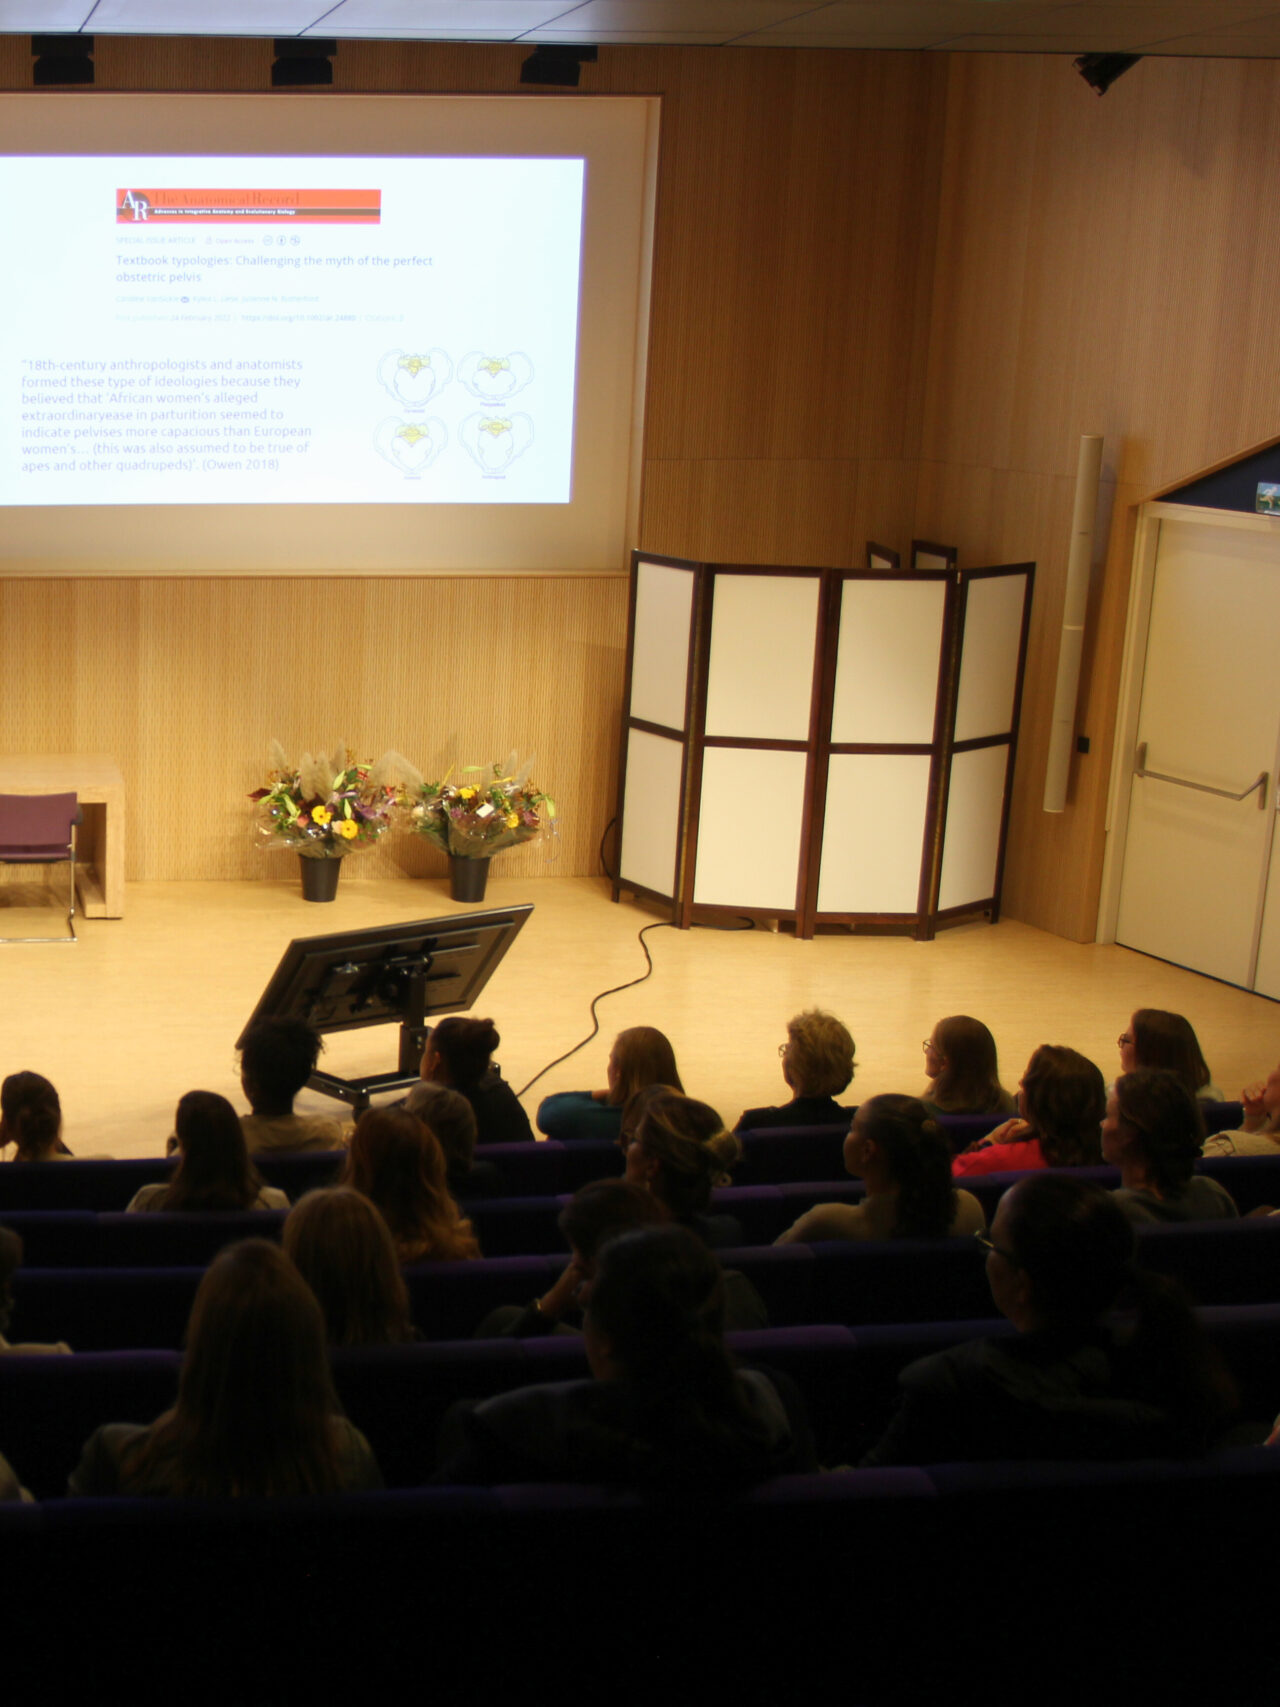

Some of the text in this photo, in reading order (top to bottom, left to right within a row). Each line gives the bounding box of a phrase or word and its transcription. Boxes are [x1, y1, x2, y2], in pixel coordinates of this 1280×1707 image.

[116, 255, 433, 268] Textbook typologies: Challenging the myth of the perfect
[115, 272, 202, 283] obstetric pelvis
[109, 359, 207, 372] anthropologists
[209, 358, 233, 369] and
[235, 360, 303, 369] anatomists
[21, 375, 301, 388] formed these type of ideologies because they
[22, 392, 74, 403] believed
[77, 392, 103, 403] that
[213, 391, 258, 405] alleged
[21, 408, 284, 422] extraordinaryease in parturition seemed to
[21, 425, 312, 439] indicate pelvises more capacious than European
[92, 442, 120, 455] (this
[122, 445, 147, 453] was
[148, 442, 174, 453] also
[176, 442, 230, 453] assumed
[232, 443, 247, 452] to
[248, 441, 265, 453] be
[267, 443, 294, 452] true
[296, 441, 310, 452] of
[22, 462, 50, 472] apes
[54, 459, 76, 470] and
[80, 459, 112, 470] other
[202, 459, 242, 471] (Owen
[246, 458, 279, 470] 2018)
